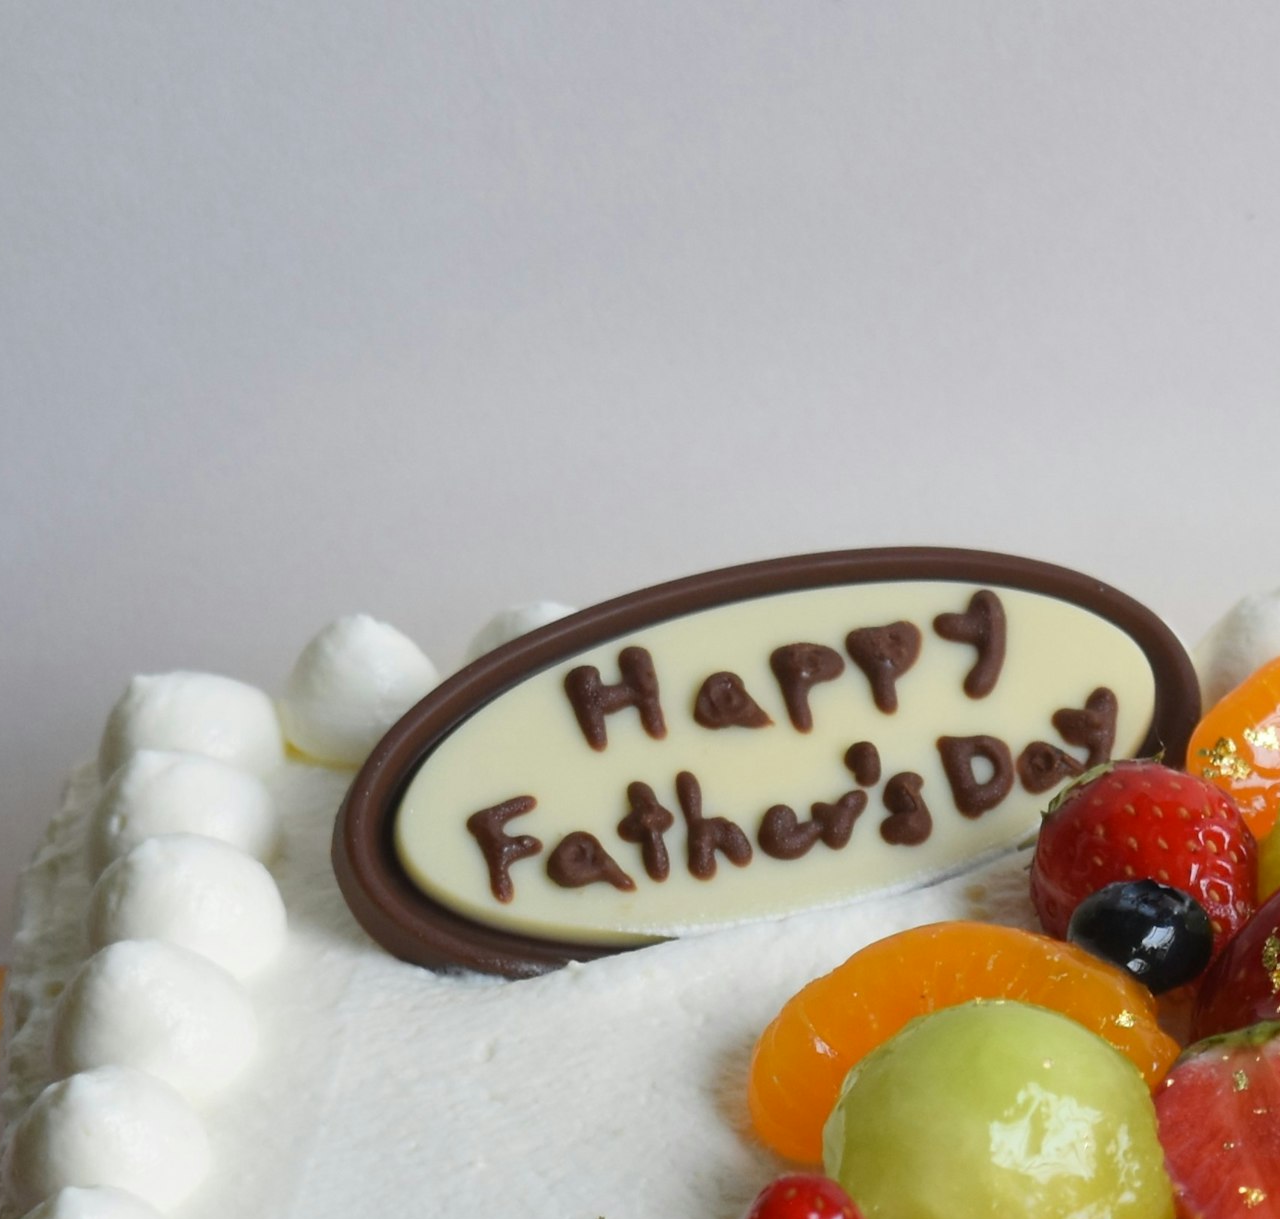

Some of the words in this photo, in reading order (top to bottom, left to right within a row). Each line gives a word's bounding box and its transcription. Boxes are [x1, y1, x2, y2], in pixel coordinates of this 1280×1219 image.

[563, 589, 1006, 751] Happy
[466, 741, 933, 904] Father's
[937, 686, 1119, 818] Day
